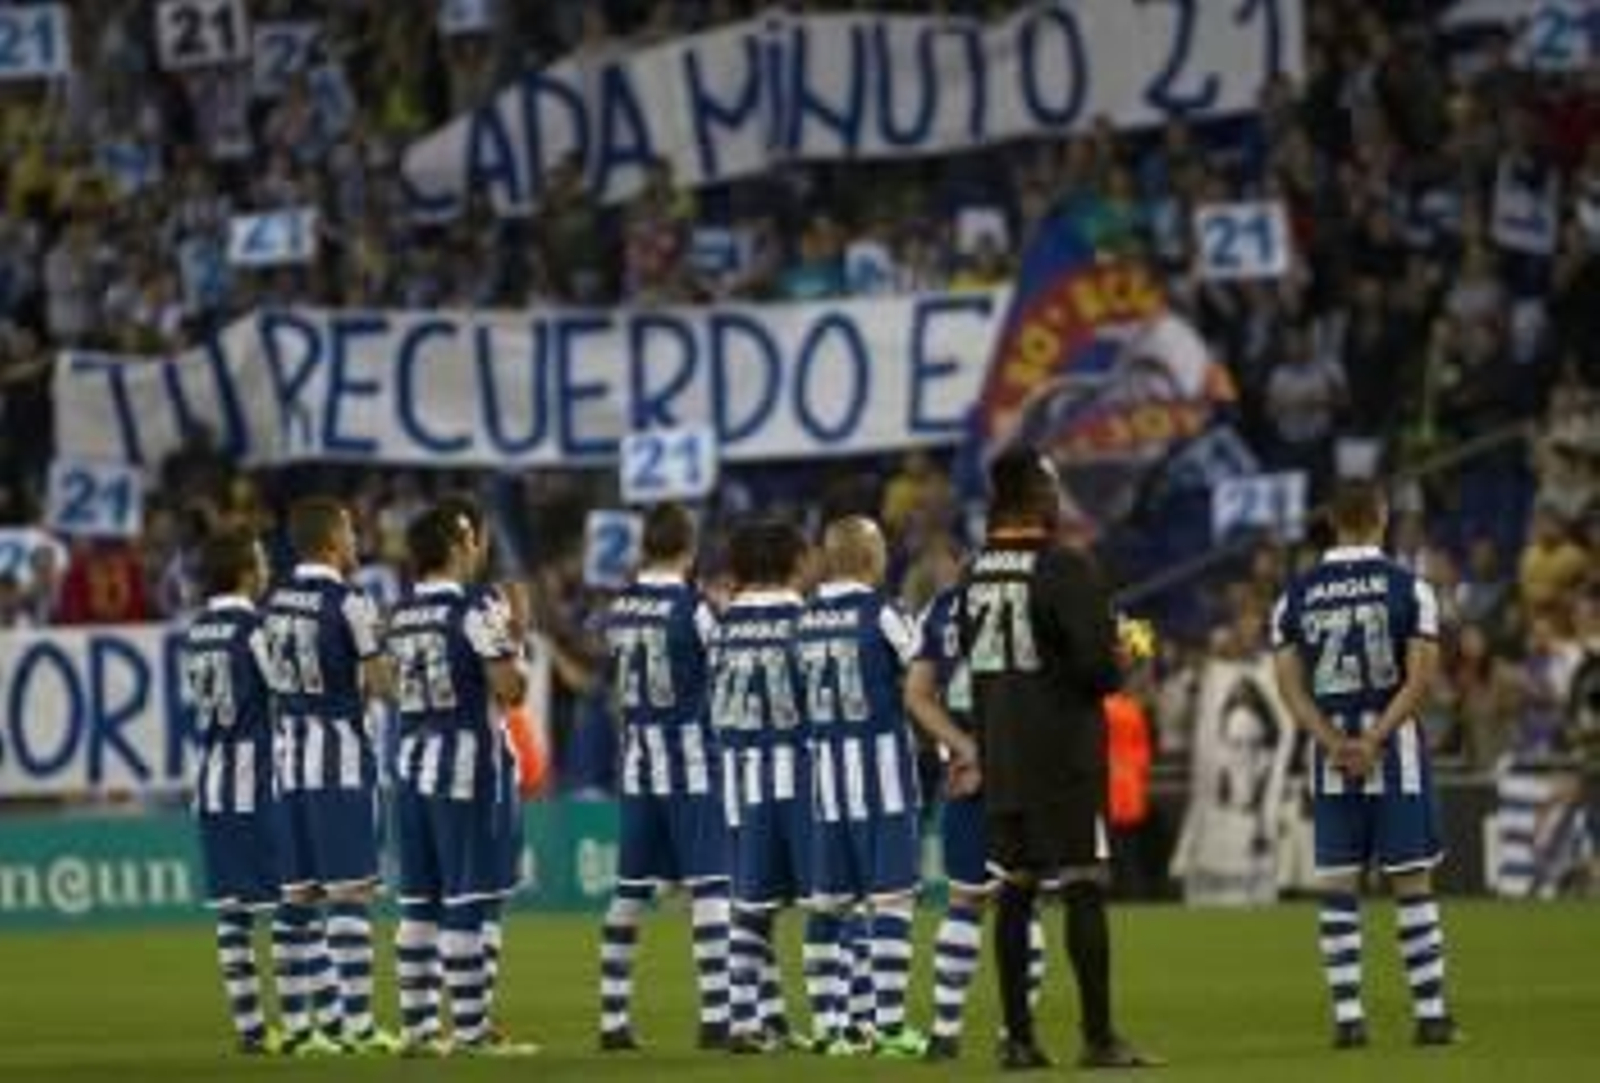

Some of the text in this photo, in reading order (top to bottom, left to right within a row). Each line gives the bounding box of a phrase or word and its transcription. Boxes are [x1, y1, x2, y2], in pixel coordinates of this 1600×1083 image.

[0, 15, 54, 68] 21
[171, 6, 237, 58] 21
[1133, 0, 1283, 113] 21
[1206, 215, 1274, 268] 21
[260, 310, 870, 455] RECUERDO
[631, 435, 702, 489] 21
[58, 468, 132, 525] 21
[966, 582, 1043, 672] 21
[1300, 602, 1400, 698] 21
